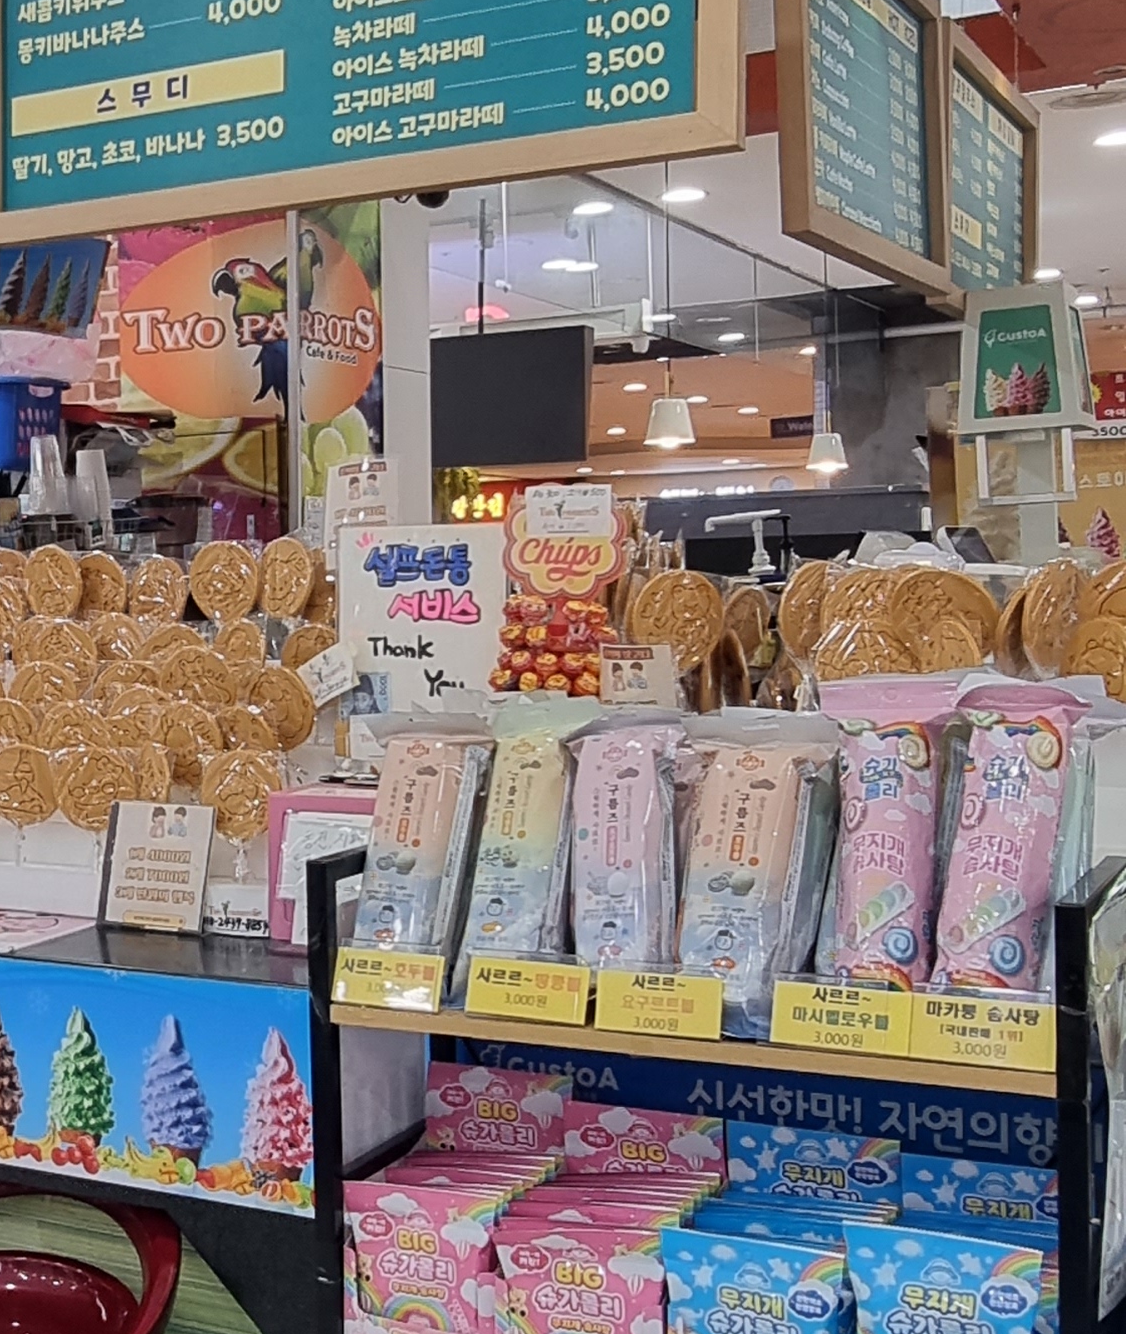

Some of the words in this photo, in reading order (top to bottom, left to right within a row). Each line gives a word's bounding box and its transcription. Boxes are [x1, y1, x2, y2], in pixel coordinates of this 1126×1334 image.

[18, 17, 146, 65] 몽키바나나주스
[333, 12, 416, 48] 녹차라떼
[333, 52, 393, 79] 아이스
[399, 35, 485, 71] 녹차라떼
[587, 3, 671, 39] 4,000
[97, 74, 188, 113] 스무디
[333, 79, 435, 116] 고구마라떼
[586, 41, 665, 76] 3,500
[333, 119, 393, 146] 아이스
[398, 102, 504, 139] 고구마라떼
[586, 77, 670, 112] 4,000
[12, 154, 53, 181] 딸기,
[57, 147, 97, 174] 망고,
[101, 141, 141, 165] 초코,
[145, 129, 205, 157] 바나나
[216, 116, 284, 148] 3,500
[387, 588, 481, 624] 서비스
[367, 635, 434, 659] Thank
[504, 992, 547, 1008] 3,000원
[633, 1015, 679, 1031] 3,000원
[987, 1006, 1040, 1026] 솜사탕
[813, 1031, 864, 1048] 3,000원
[953, 1042, 1007, 1058] 3,000원
[476, 1099, 519, 1122] BIG
[620, 1140, 666, 1162] BIG
[396, 1230, 437, 1253] BIG
[555, 1261, 604, 1289] BIG
[719, 1288, 785, 1320] 무지개
[901, 1284, 975, 1319] 무지개
